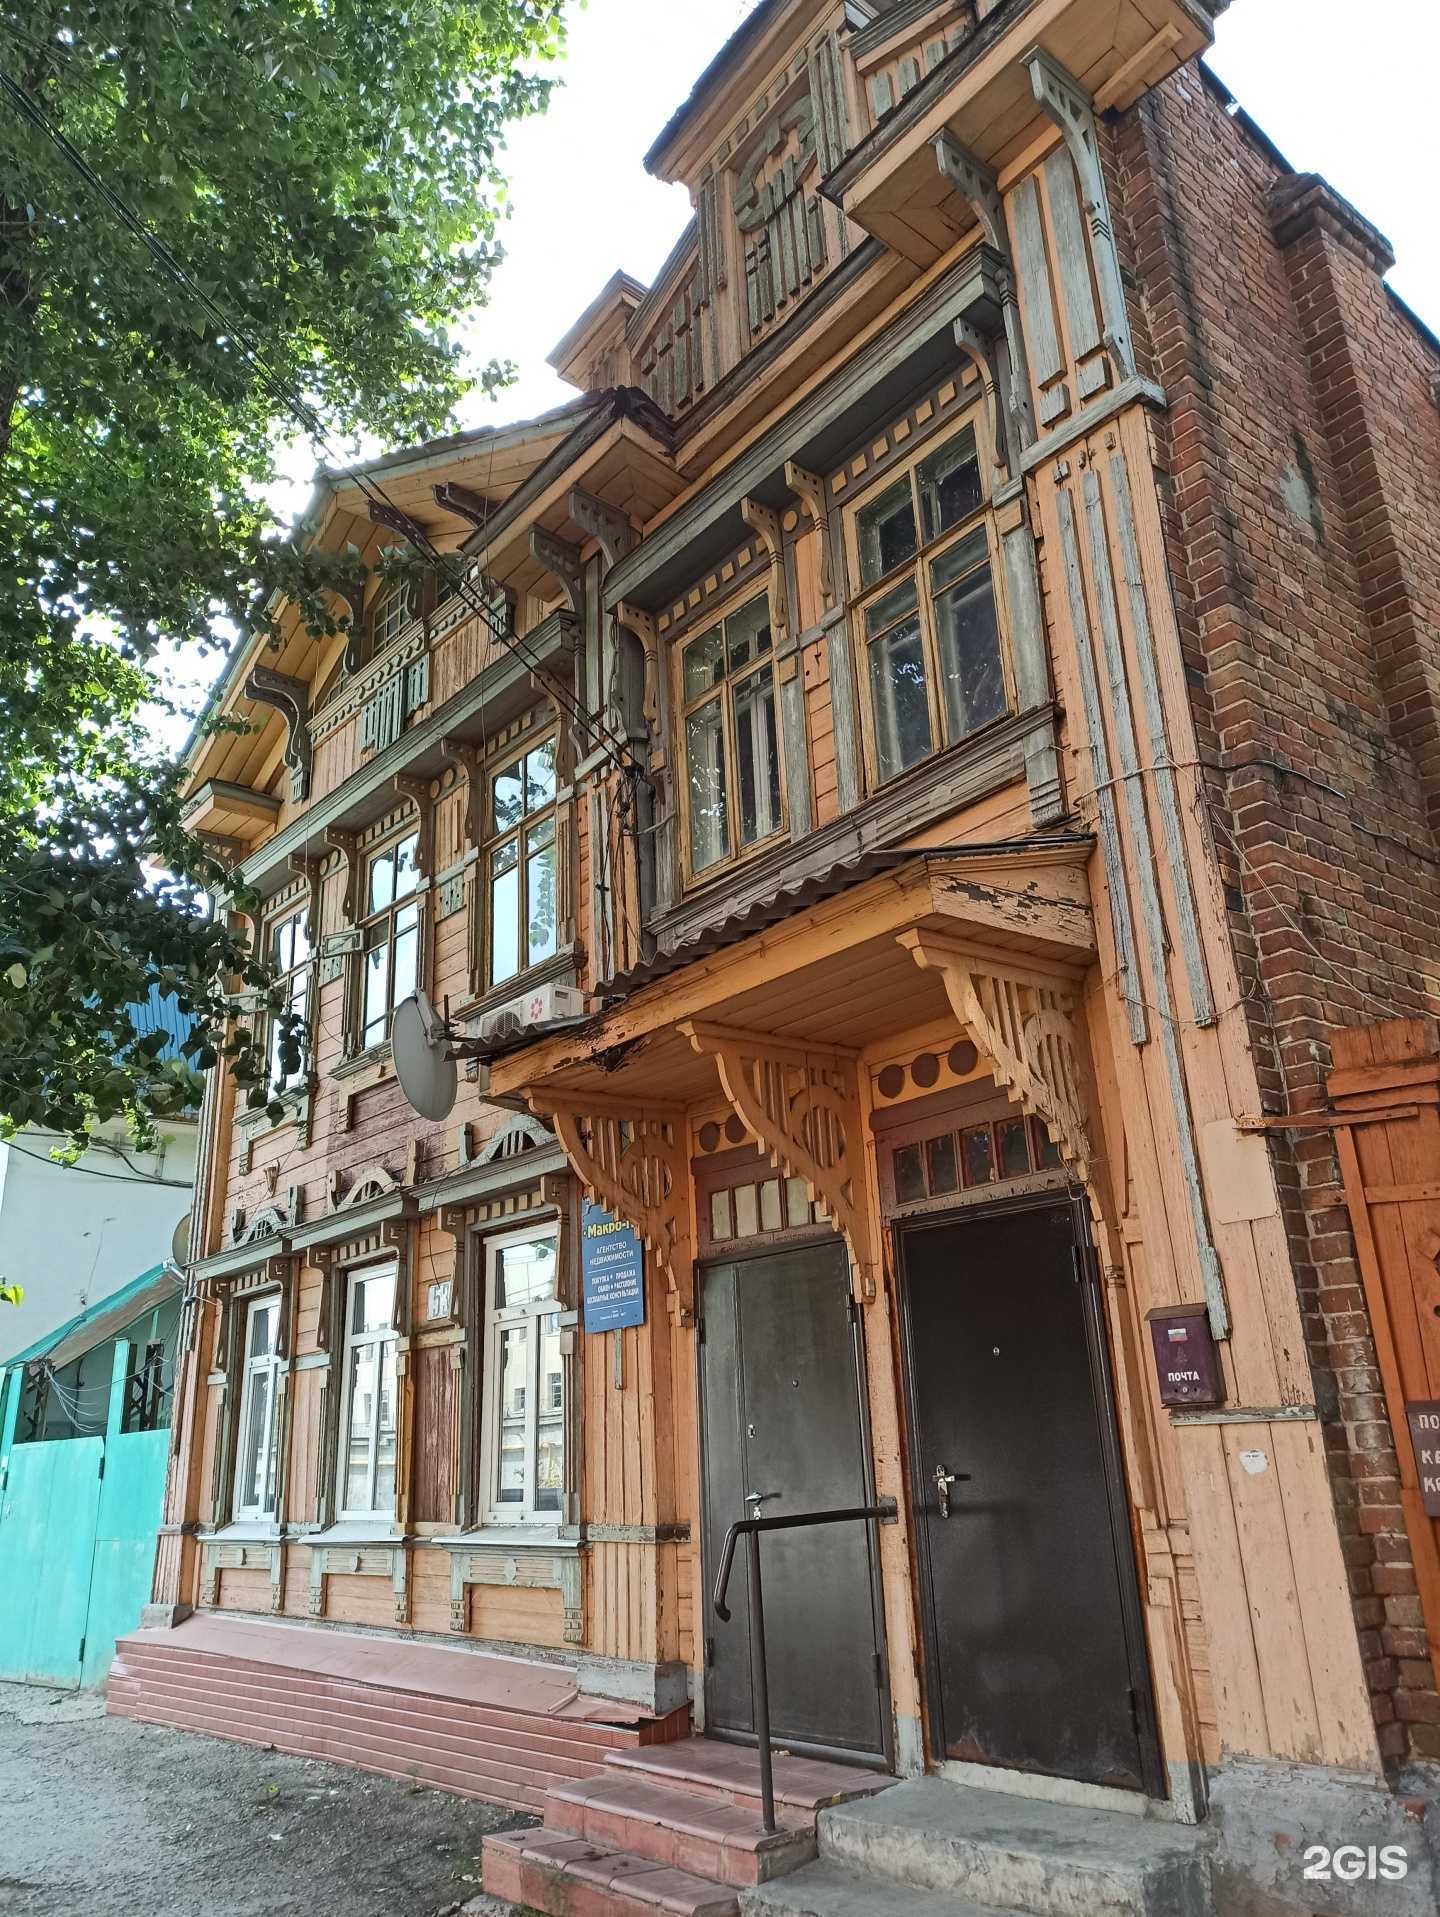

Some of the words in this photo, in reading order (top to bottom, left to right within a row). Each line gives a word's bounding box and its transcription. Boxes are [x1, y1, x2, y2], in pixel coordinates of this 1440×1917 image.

[596, 1241, 627, 1254] АГЕНТСТВО
[590, 1250, 634, 1265] НЕДВИЖИМОСТИ
[1168, 1371, 1200, 1382] ПОЧТА
